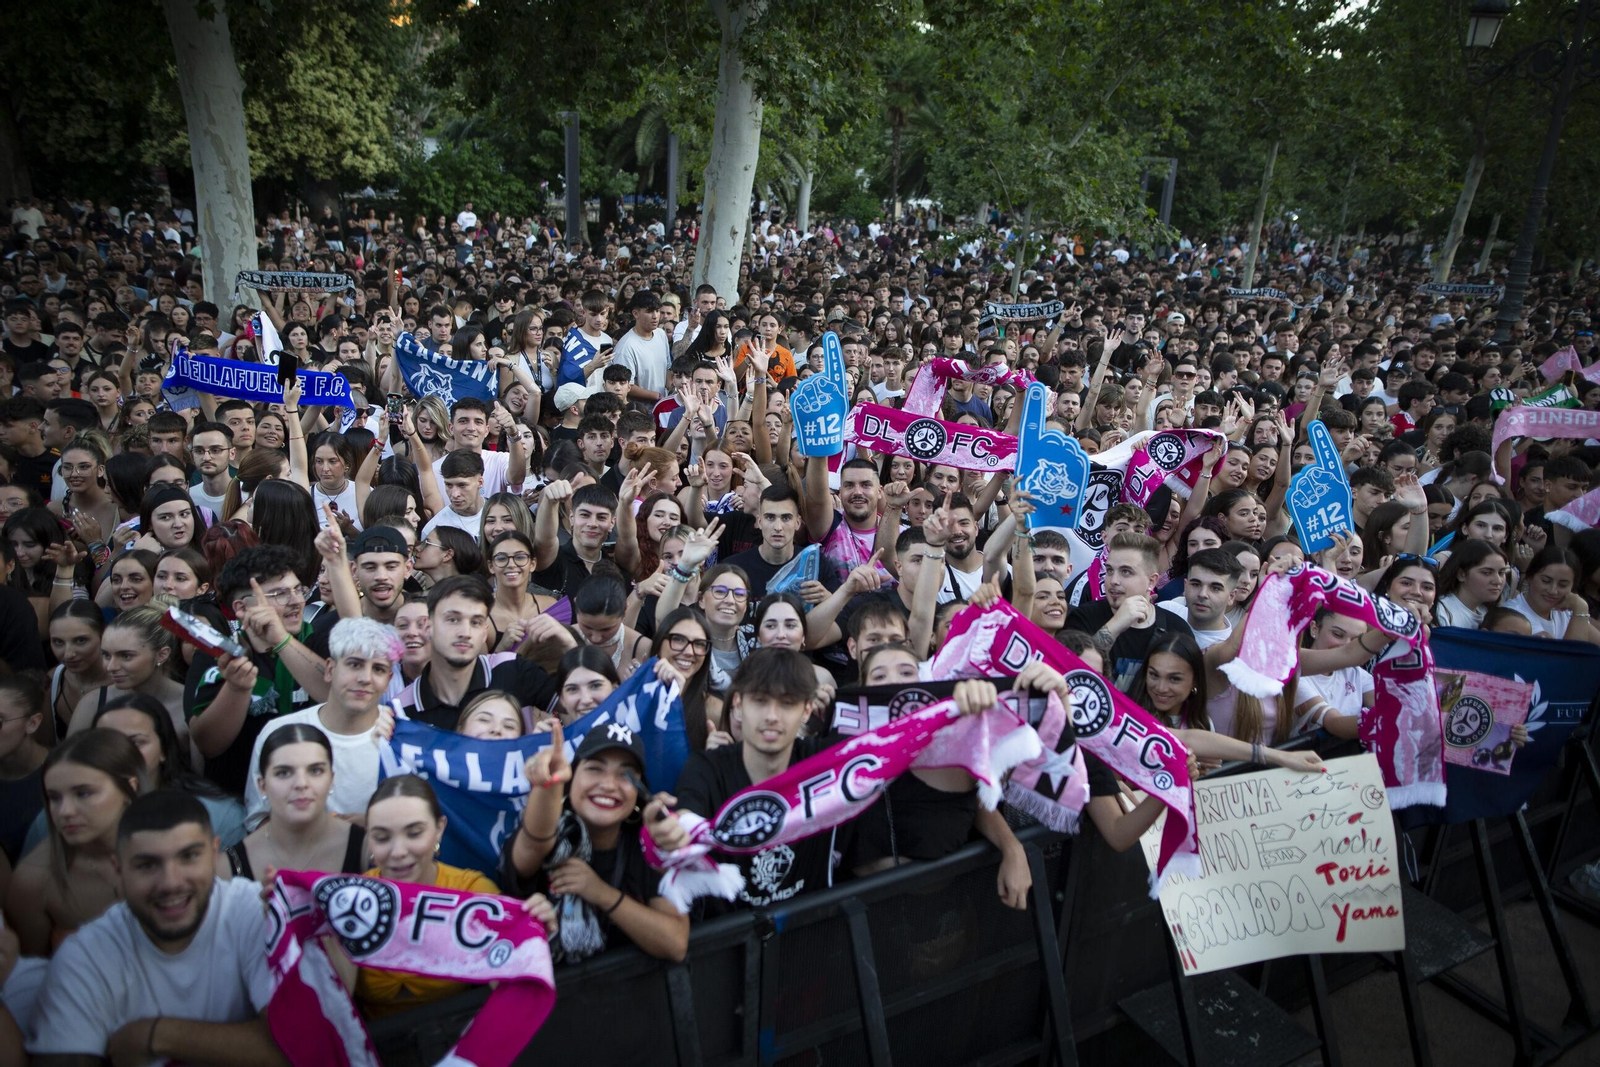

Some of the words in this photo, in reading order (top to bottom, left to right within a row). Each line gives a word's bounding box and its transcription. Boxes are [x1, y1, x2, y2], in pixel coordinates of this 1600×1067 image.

[179, 355, 306, 395] DELLAFUENE
[804, 412, 841, 436] #12
[863, 416, 897, 443] DL
[806, 435, 841, 446] PLAYER
[1306, 501, 1346, 532] #12
[1309, 521, 1348, 543] PLAYER
[1112, 716, 1174, 771] FC
[1260, 829, 1279, 842] DE
[1312, 828, 1389, 857] noche
[1264, 850, 1301, 865] ESTAR
[410, 893, 503, 950] FC
[1177, 874, 1326, 955] GRANADA
